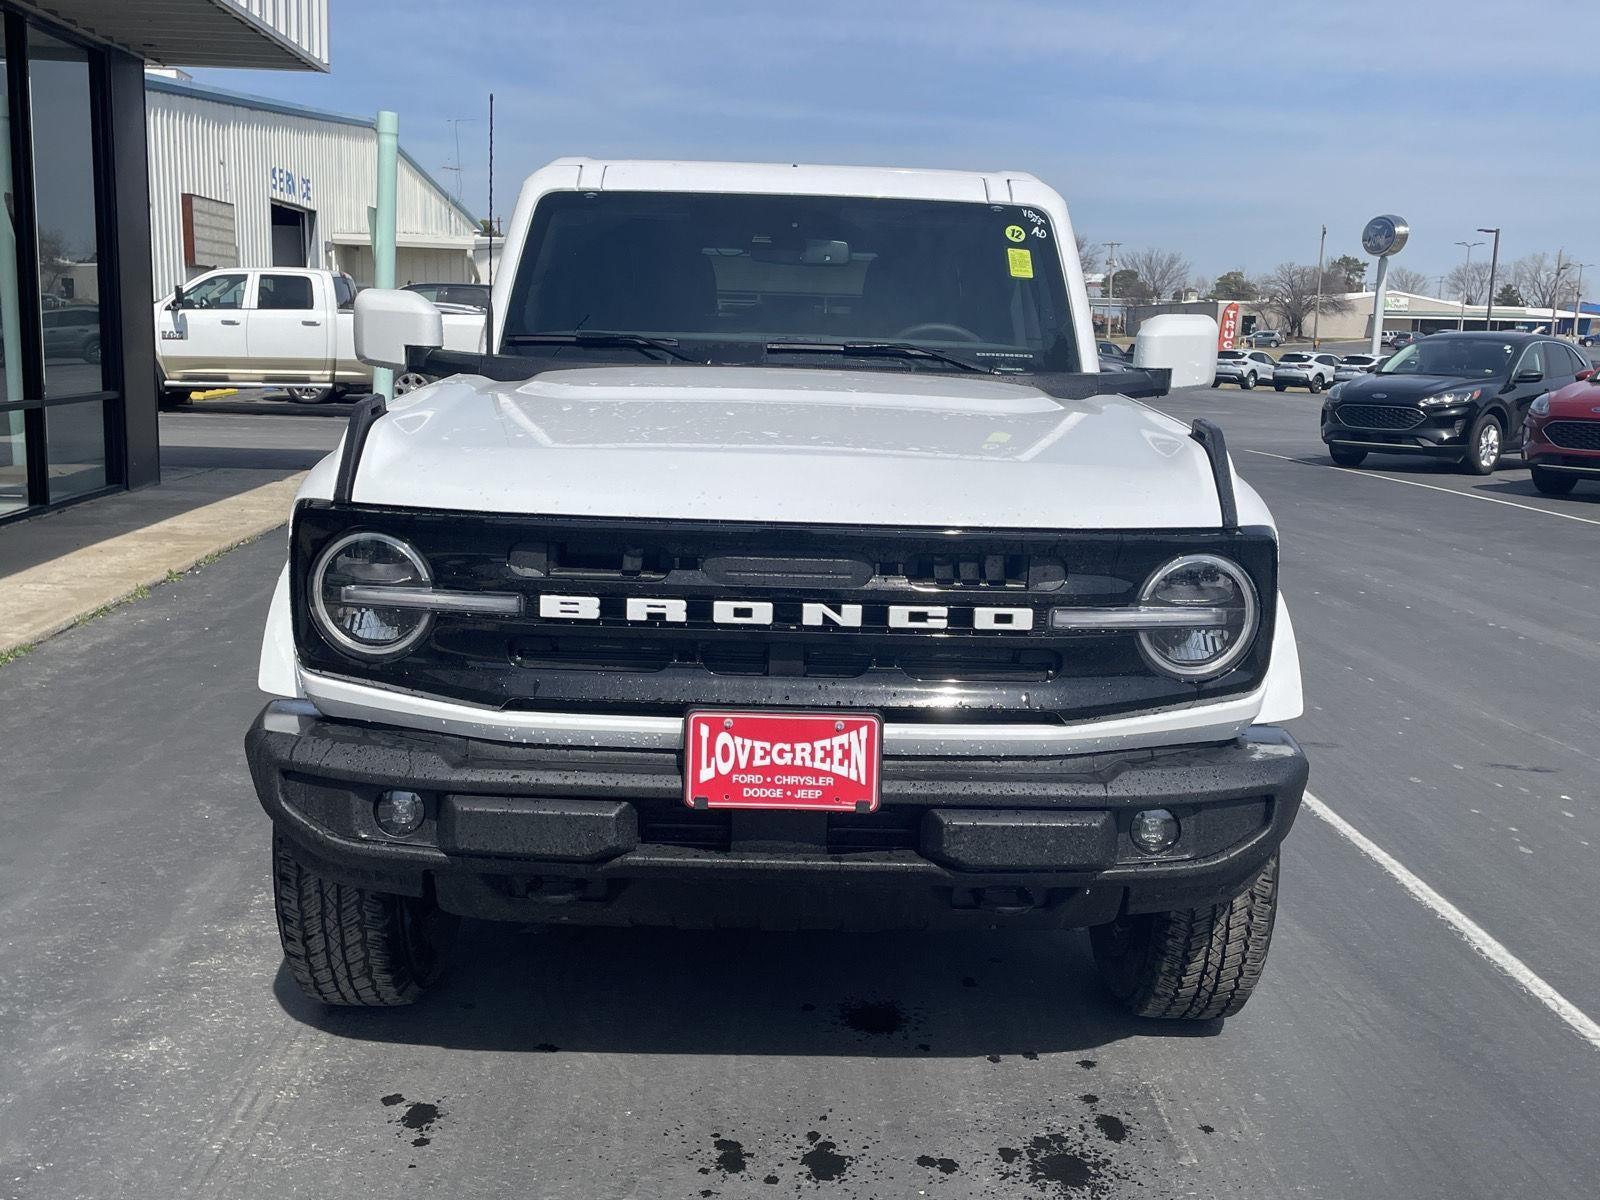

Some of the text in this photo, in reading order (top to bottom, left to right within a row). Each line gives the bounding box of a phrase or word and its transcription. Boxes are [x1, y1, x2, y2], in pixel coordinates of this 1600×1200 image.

[1010, 228, 1023, 240] 12
[539, 594, 1034, 631] BRONCO
[699, 722, 868, 786] LOVEGREEN
[732, 774, 834, 786] FORD CHRYSLER
[743, 787, 823, 799] DODGE JEEP
